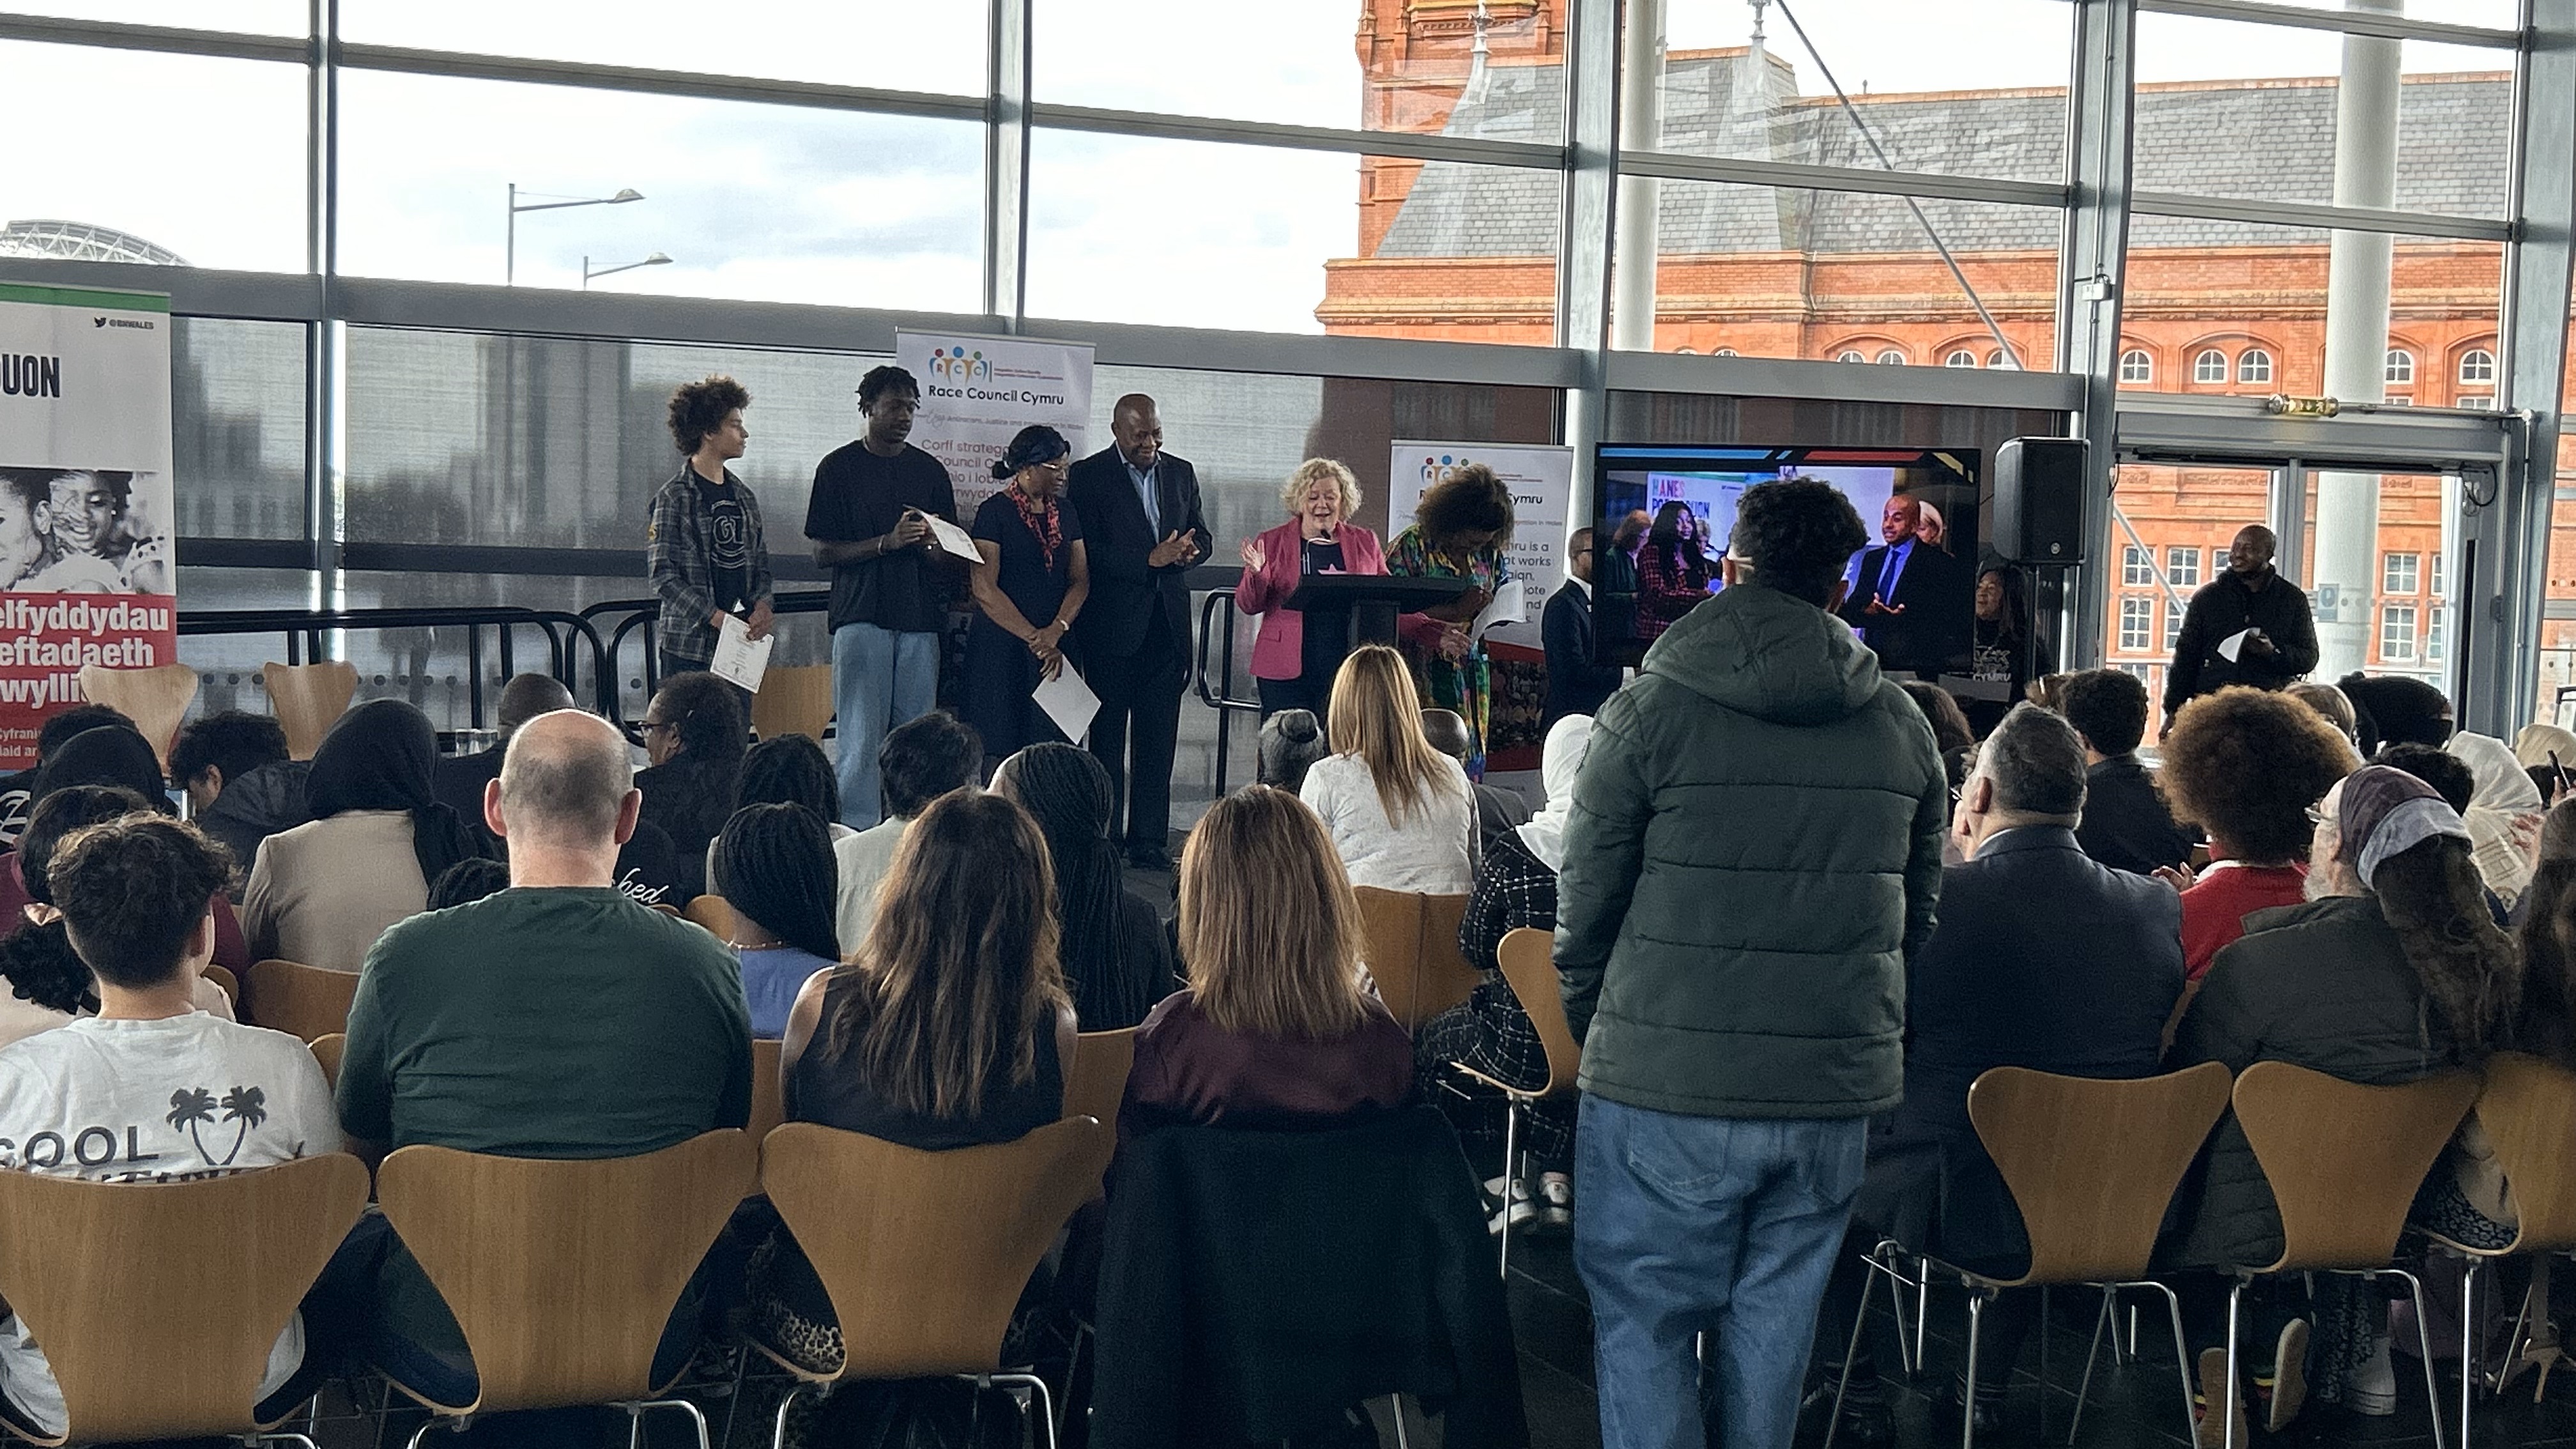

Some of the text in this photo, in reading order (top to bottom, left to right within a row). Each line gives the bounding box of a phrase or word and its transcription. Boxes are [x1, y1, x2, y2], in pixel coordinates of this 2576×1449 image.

[0, 353, 60, 397] UON
[928, 385, 1064, 406] Race Council Cymru
[922, 440, 953, 452] Corff
[1529, 542, 1538, 551] is
[1518, 556, 1551, 566] works
[1524, 586, 1545, 595] ote
[0, 673, 88, 709] wylli
[611, 868, 669, 903] hed
